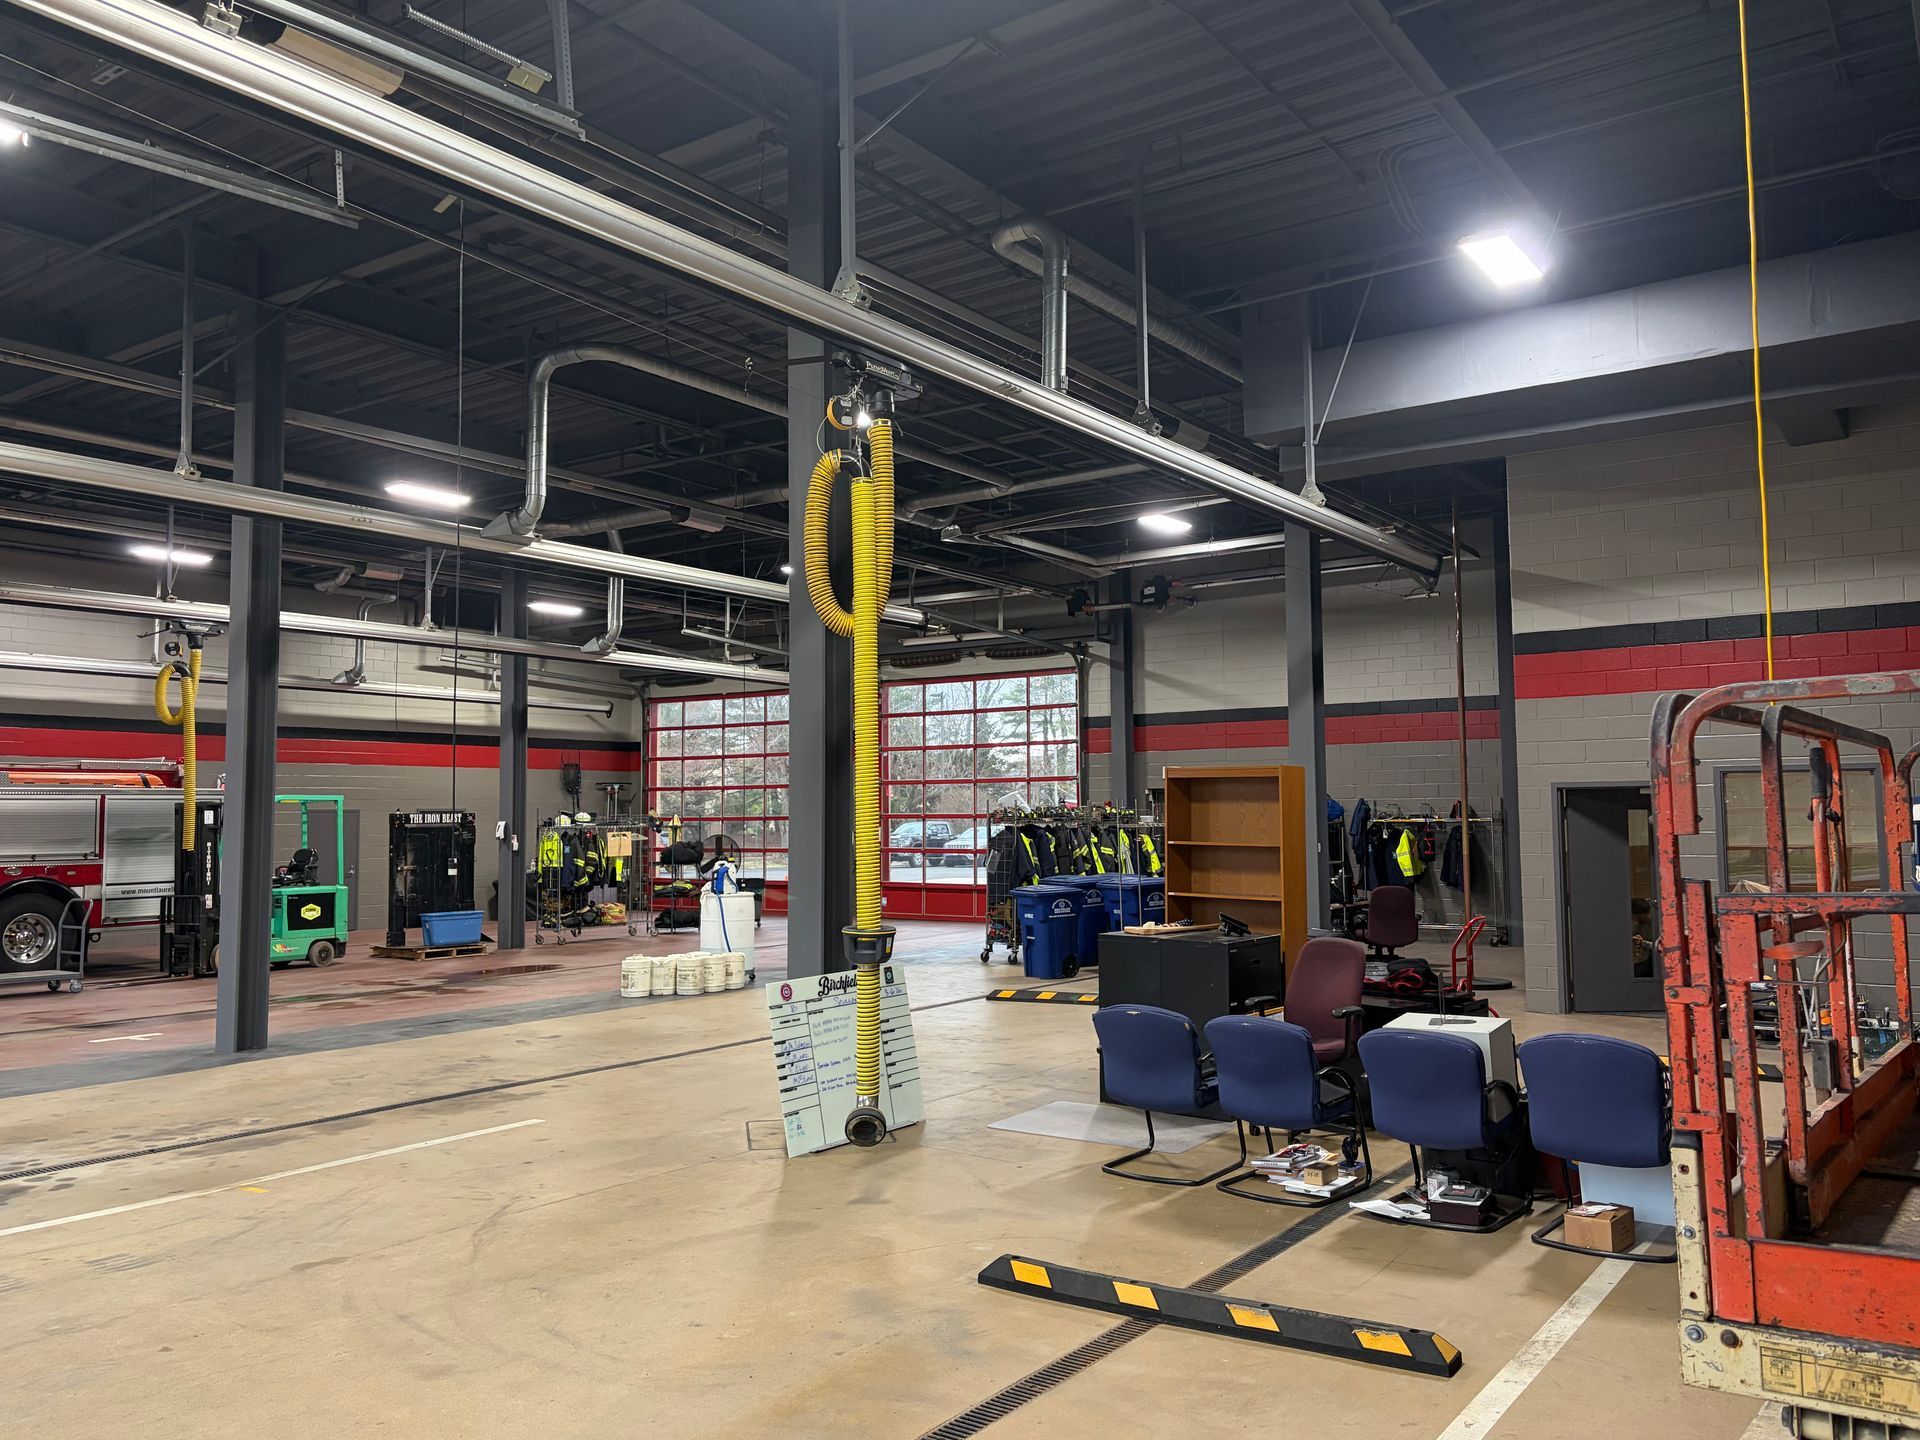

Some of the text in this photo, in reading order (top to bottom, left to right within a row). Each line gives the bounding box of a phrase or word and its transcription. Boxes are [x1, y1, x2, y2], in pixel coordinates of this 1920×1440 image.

[409, 813, 423, 824] THE
[424, 813, 440, 824] IRON
[121, 886, 175, 895] www.mountlaurel
[818, 974, 857, 997] Birchfiel
